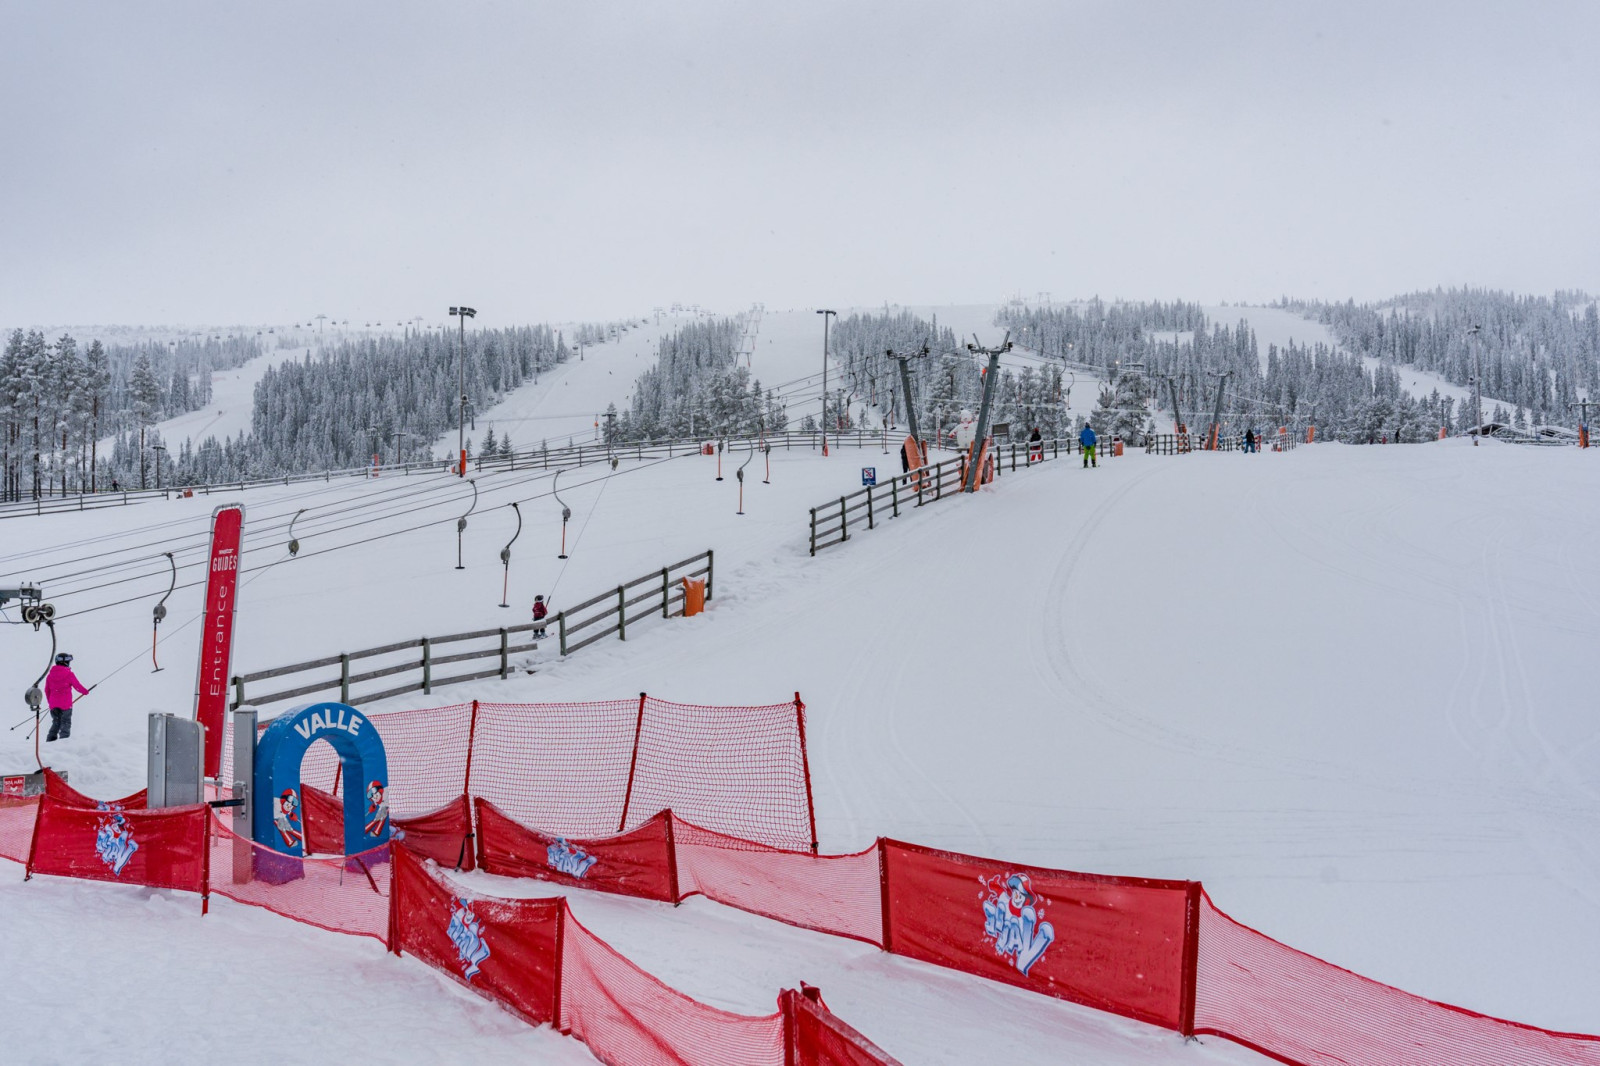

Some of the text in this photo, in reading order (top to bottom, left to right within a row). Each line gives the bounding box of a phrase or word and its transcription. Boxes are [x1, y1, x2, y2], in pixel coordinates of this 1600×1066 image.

[212, 554, 238, 572] GUIDES
[210, 585, 228, 696] Entrance
[294, 708, 363, 740] VALLE
